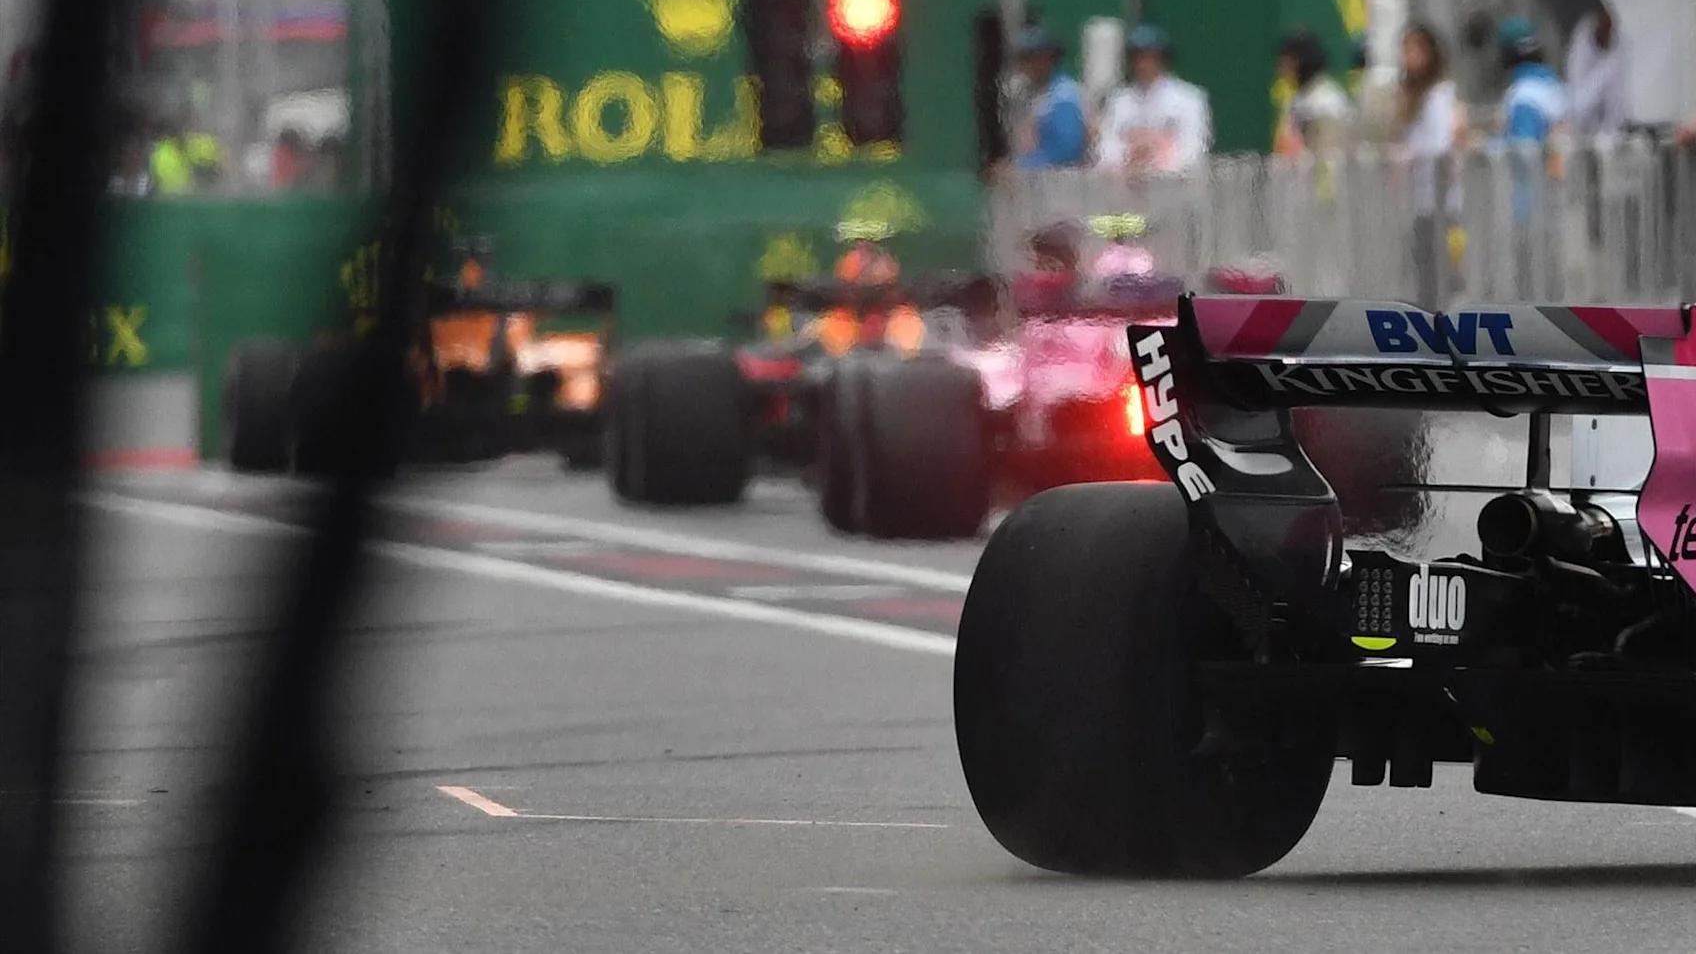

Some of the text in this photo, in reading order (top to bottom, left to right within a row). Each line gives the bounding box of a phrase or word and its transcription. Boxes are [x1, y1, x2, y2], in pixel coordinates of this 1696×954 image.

[1366, 309, 1517, 356] BWT
[1256, 363, 1645, 401] KINGFISHER
[1136, 330, 1216, 502] HYPE
[1409, 563, 1467, 631] duo
